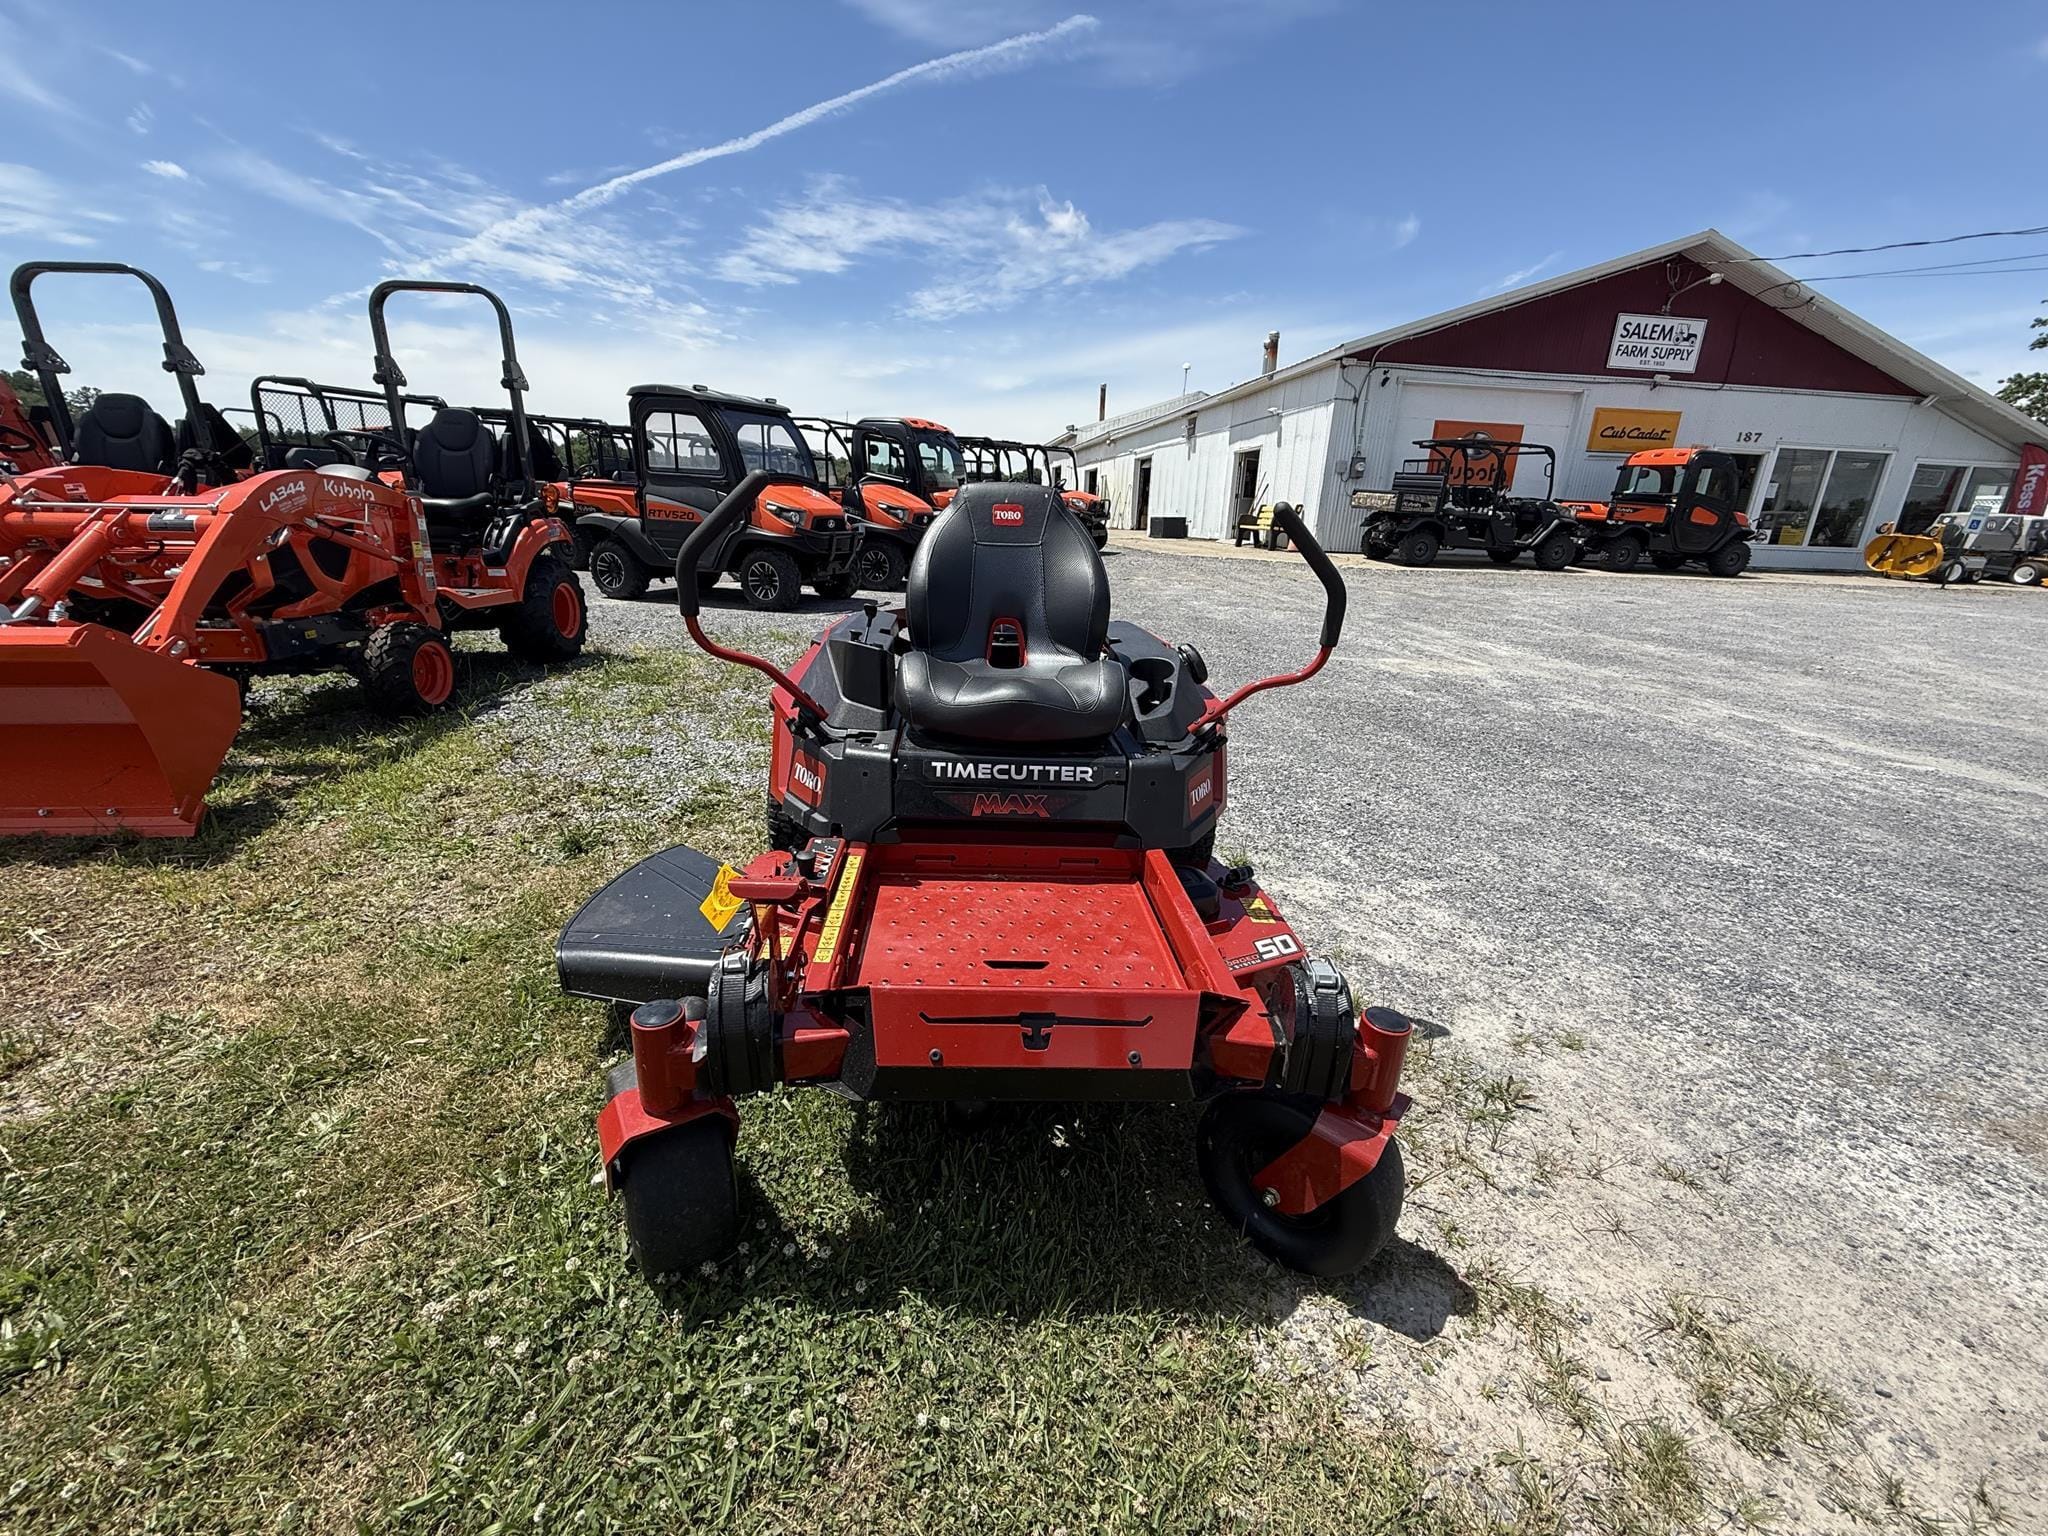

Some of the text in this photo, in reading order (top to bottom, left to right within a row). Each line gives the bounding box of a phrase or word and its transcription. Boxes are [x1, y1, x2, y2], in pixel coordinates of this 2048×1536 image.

[1620, 321, 1674, 341] SALEM
[1615, 344, 1694, 361] FARM SUPPLY
[1600, 426, 1671, 441] Cub Cadet
[1736, 431, 1763, 443] 187
[1439, 462, 1507, 482] ubot
[260, 481, 305, 512] LA344
[323, 479, 376, 501] Kubota
[2017, 464, 2046, 508] Kress
[648, 508, 695, 521] RTV520
[994, 510, 1021, 520] TORO
[794, 762, 821, 792] TORO
[931, 761, 1094, 782] TIMECUTTER
[1190, 778, 1210, 806] TORO
[971, 793, 1050, 817] MAX
[1254, 934, 1298, 960] 50
